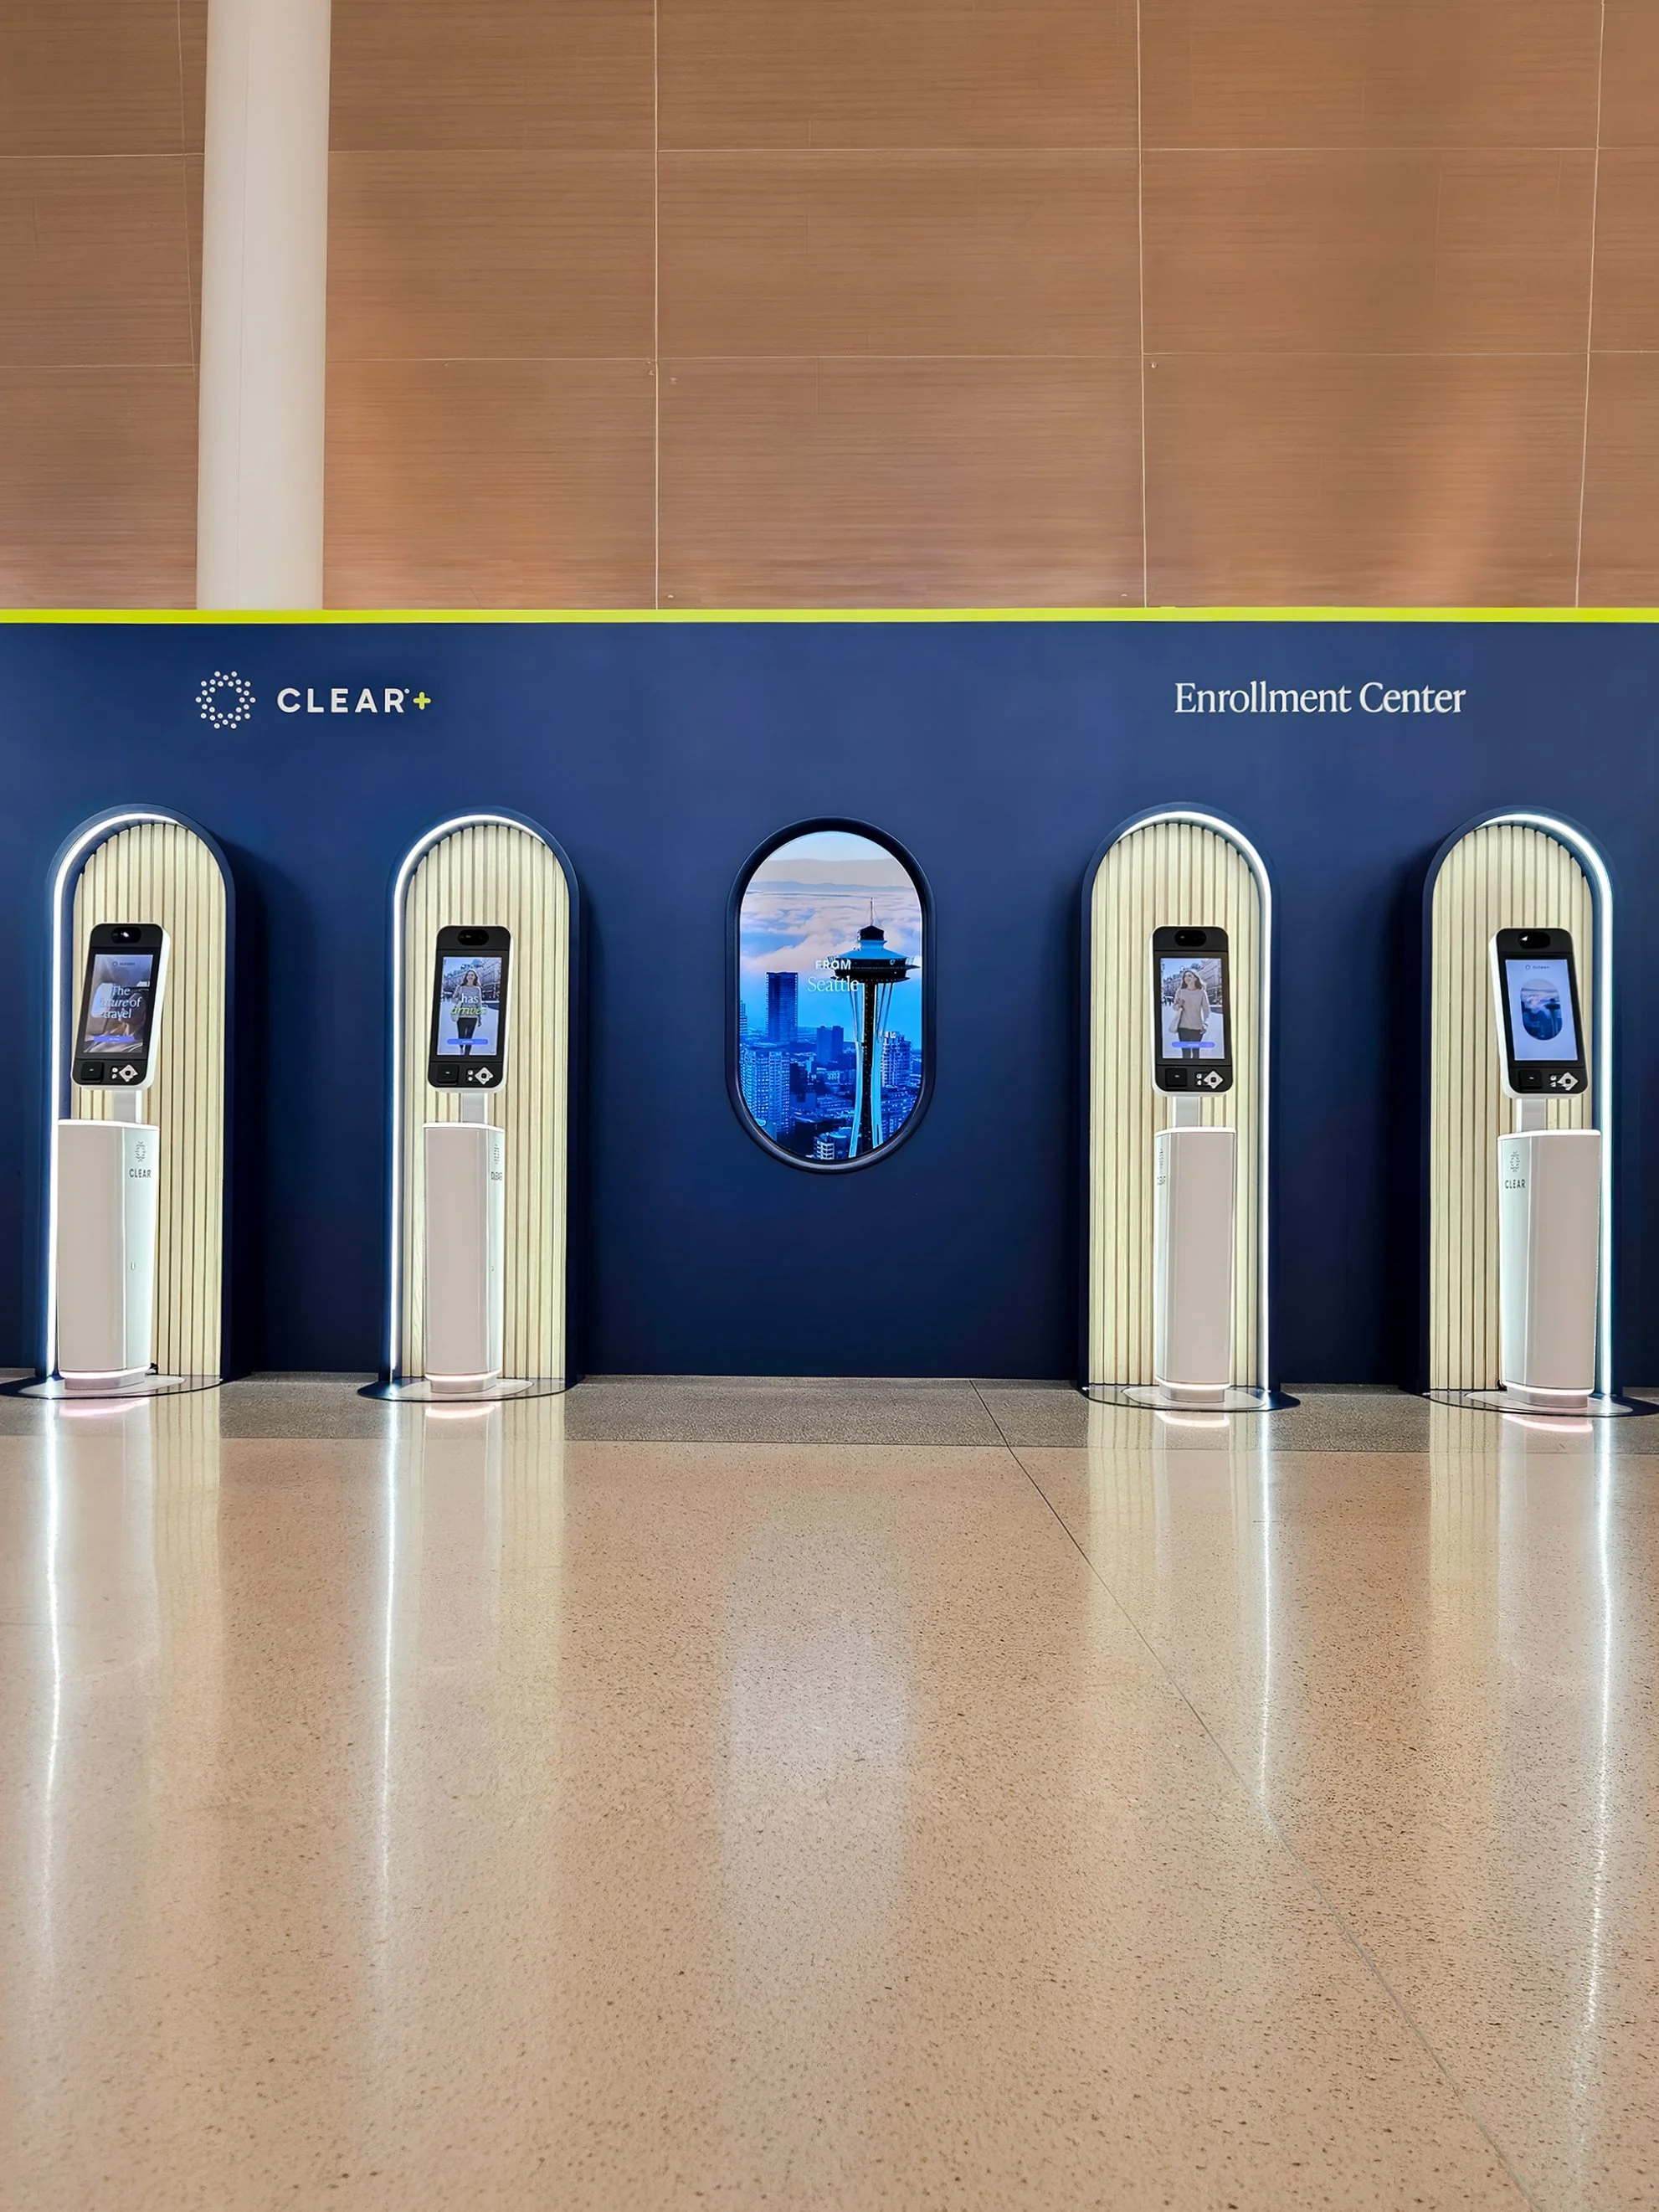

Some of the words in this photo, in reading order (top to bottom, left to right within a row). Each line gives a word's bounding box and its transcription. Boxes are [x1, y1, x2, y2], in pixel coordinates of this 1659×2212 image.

[1174, 681, 1352, 713] Enrollment
[1359, 682, 1466, 713] Center
[815, 959, 851, 970] FROM
[807, 975, 860, 992] Seattle
[112, 984, 131, 995] The
[129, 996, 143, 1007] of
[461, 993, 479, 1004] has
[102, 1008, 132, 1019] travel
[129, 1168, 152, 1178] CLEAR
[1504, 1179, 1526, 1189] CLEAR
